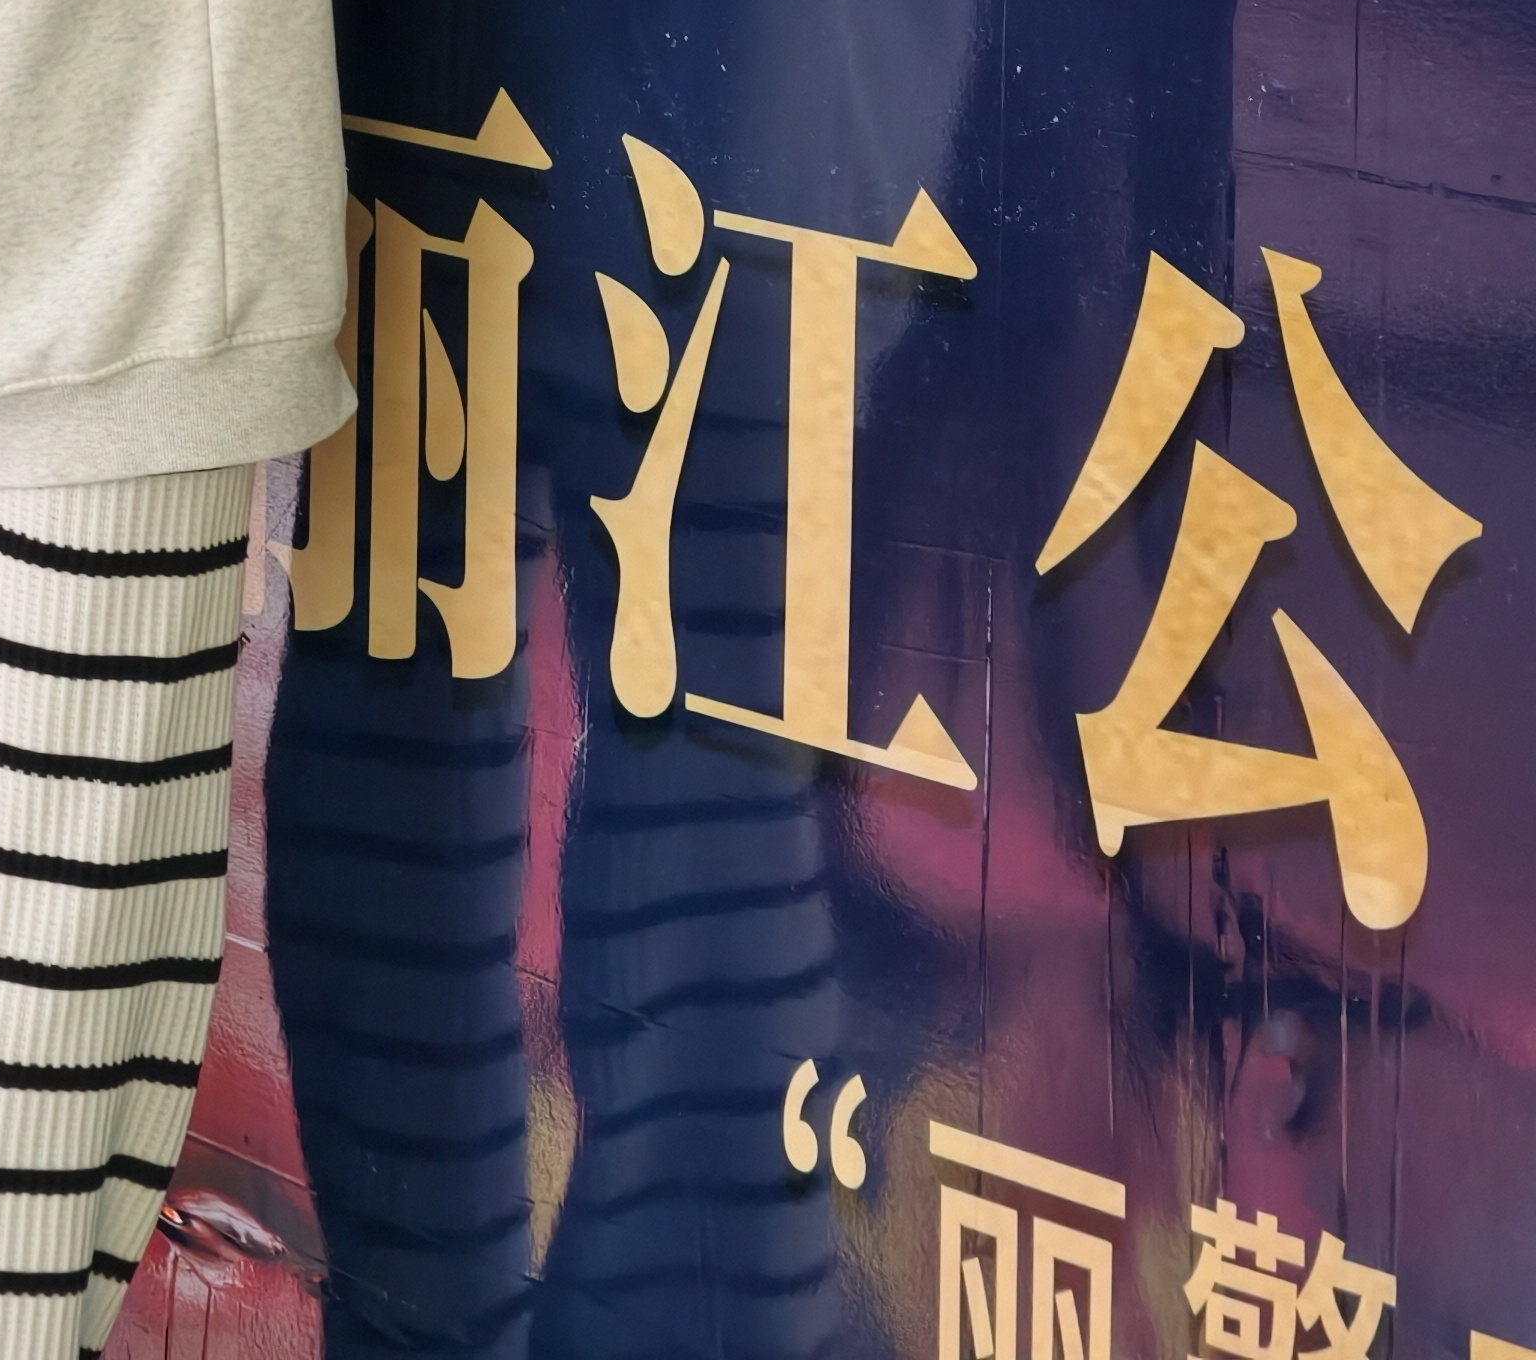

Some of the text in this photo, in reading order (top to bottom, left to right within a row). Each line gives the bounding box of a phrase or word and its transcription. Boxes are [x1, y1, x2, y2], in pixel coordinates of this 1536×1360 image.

[265, 86, 1484, 930] 丽江公
[782, 1057, 1536, 1360] “丽警
